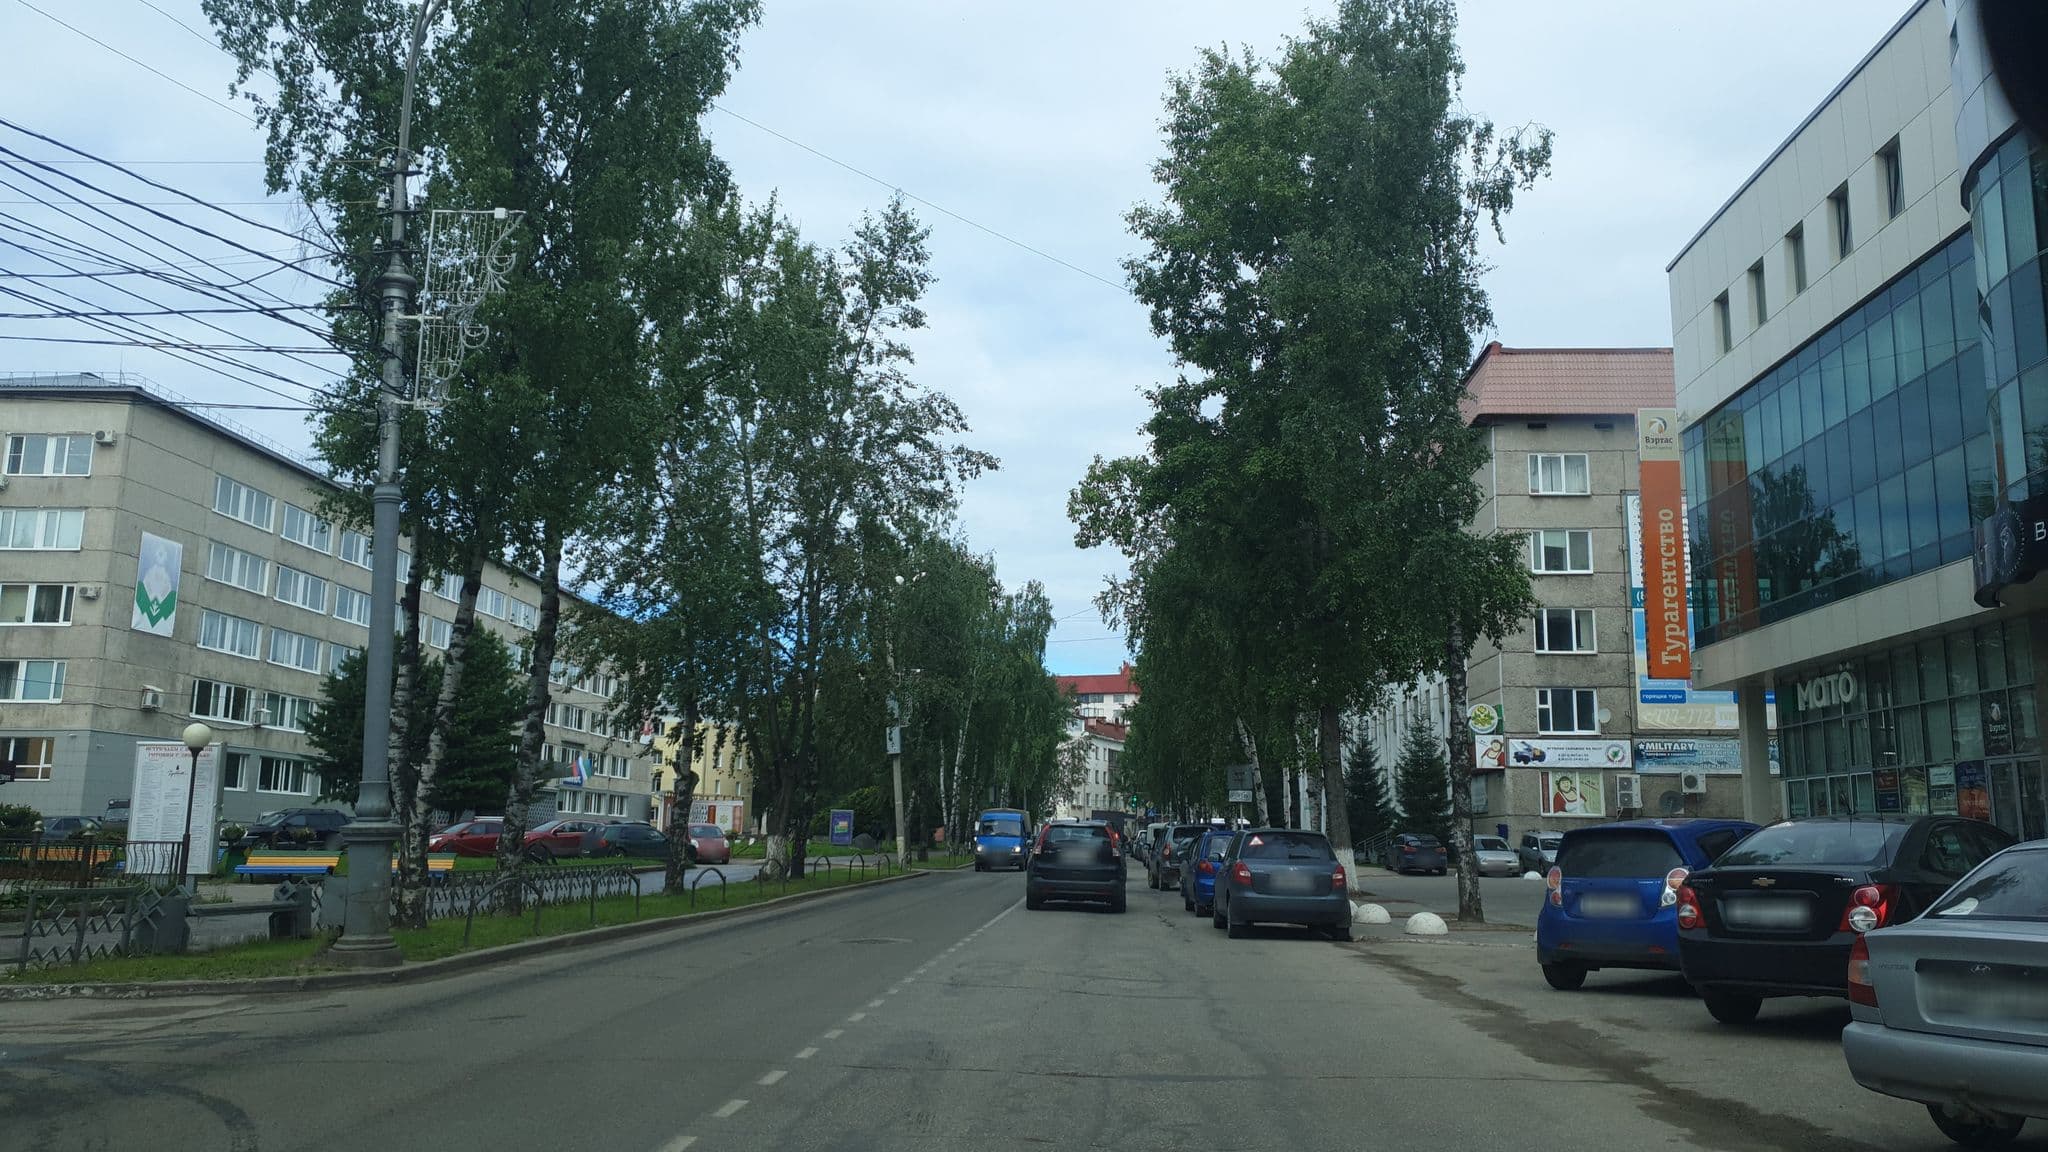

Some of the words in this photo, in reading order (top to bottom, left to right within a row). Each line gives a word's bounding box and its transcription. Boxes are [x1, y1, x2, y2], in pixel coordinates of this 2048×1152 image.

[1645, 436, 1673, 445] Вэртас
[1658, 508, 1686, 664] Турагентство
[1645, 742, 1695, 750] MILITARY
